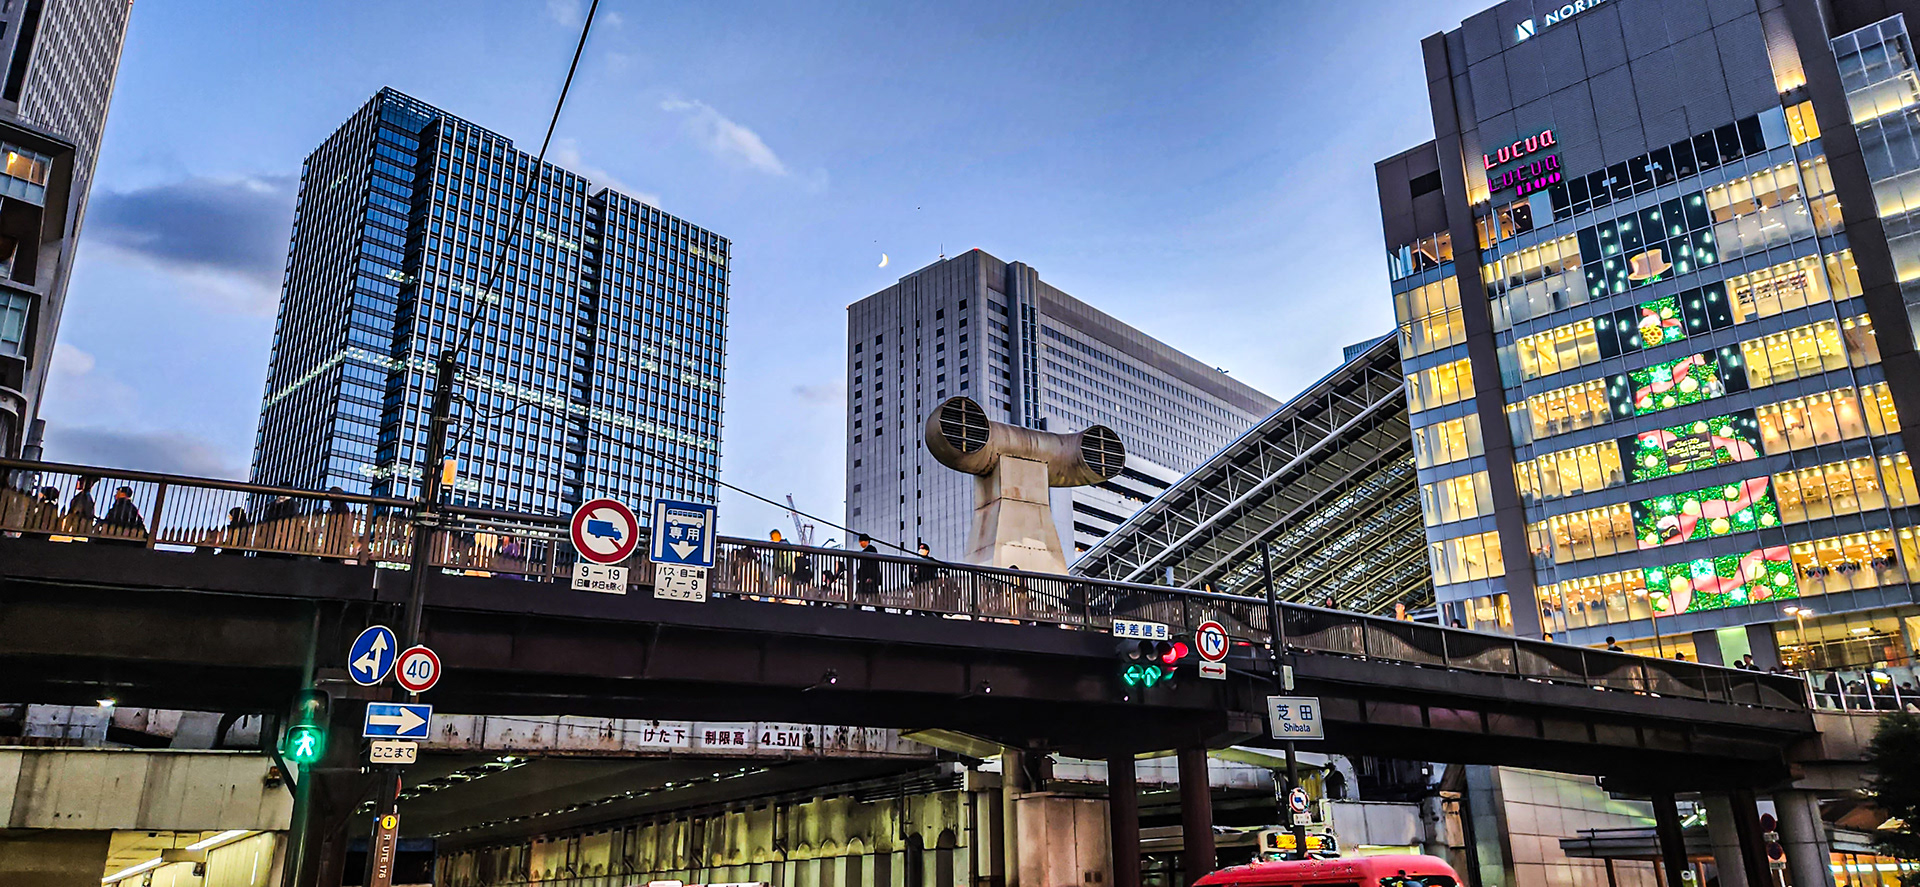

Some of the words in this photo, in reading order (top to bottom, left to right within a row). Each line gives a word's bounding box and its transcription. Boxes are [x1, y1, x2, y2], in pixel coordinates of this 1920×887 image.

[1544, 0, 1607, 27] NOR
[668, 525, 701, 542] 専用
[657, 588, 703, 600] ここから
[1115, 622, 1166, 638] 時差信号
[406, 659, 431, 679] 40
[1276, 704, 1313, 720] 芝田
[643, 728, 686, 744] けた下
[704, 730, 745, 746] 制限高
[761, 731, 800, 747] 4.5M
[373, 746, 415, 759] ここまで
[380, 834, 391, 863] RUTE
[378, 865, 388, 879] 176
